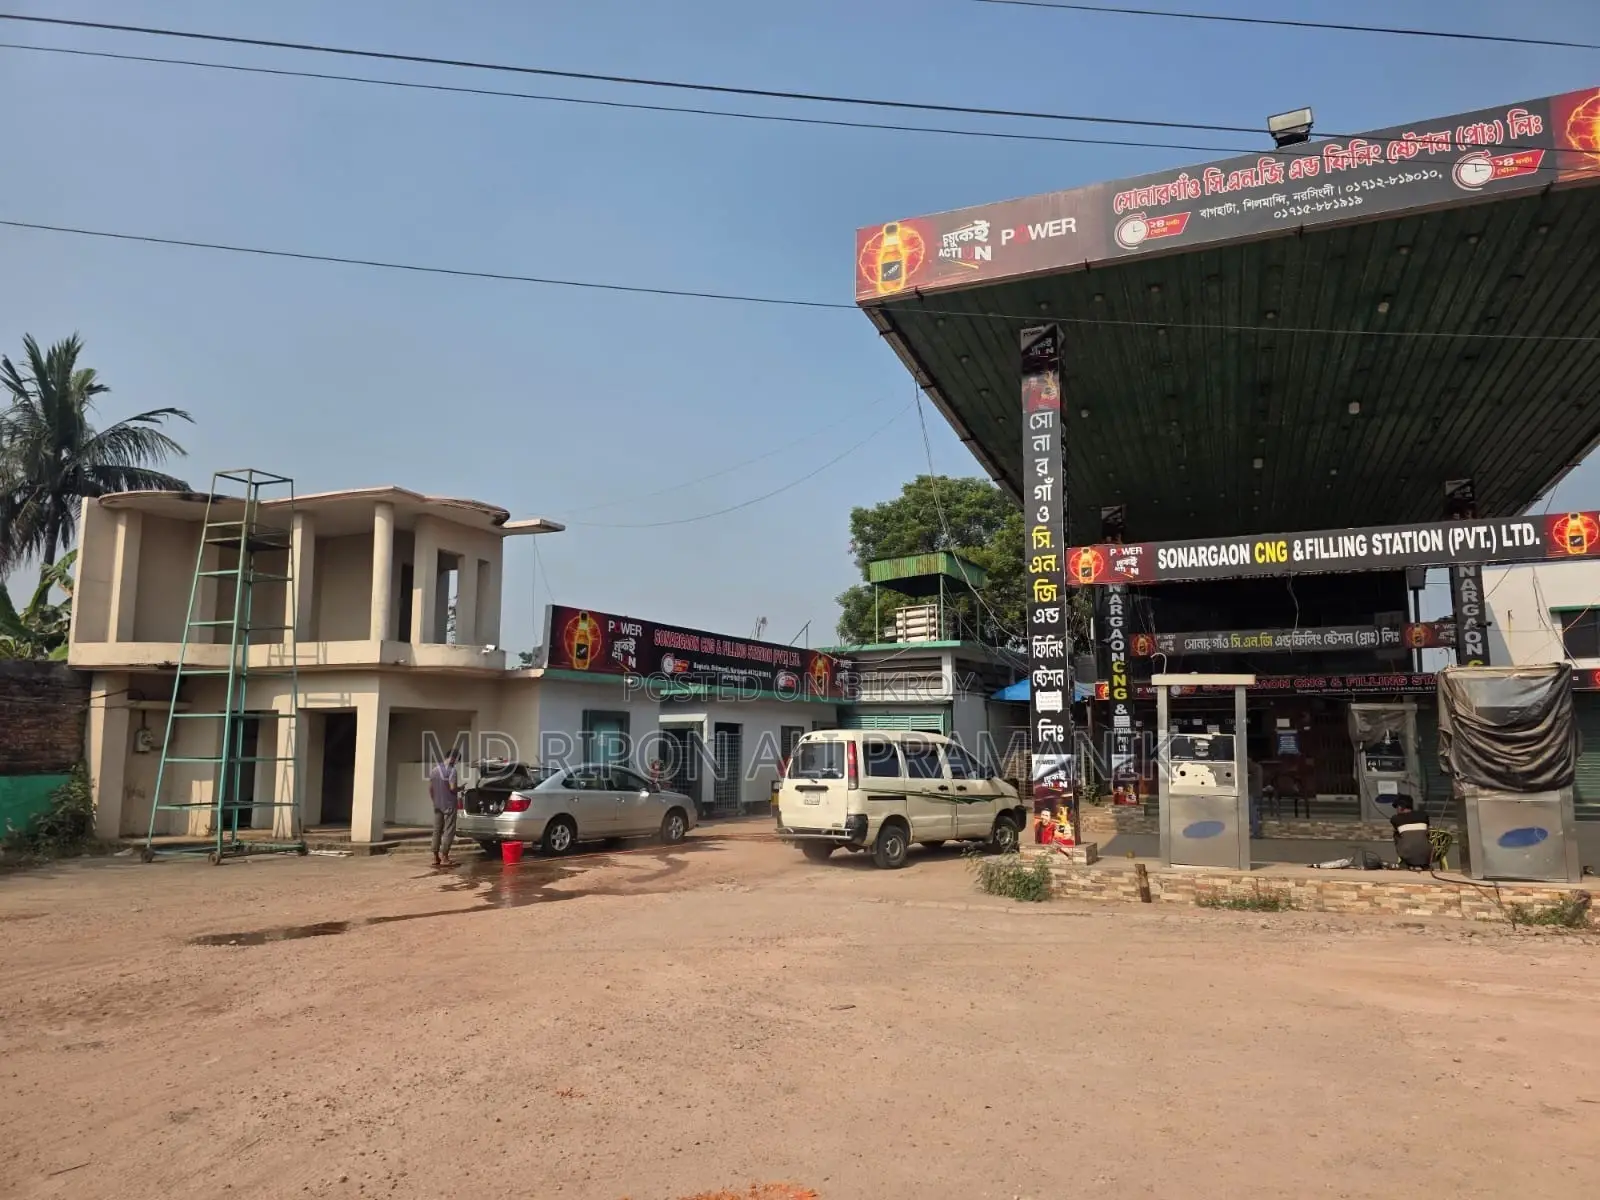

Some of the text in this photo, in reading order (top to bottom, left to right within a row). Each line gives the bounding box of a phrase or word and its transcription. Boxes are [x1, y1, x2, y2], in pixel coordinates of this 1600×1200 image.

[1113, 172, 1201, 214] সোনারগাঁও
[1289, 155, 1320, 179] এন্ড
[1323, 139, 1384, 174] ফিলিং
[1507, 108, 1543, 140] লিঃ
[1158, 542, 1250, 570] SONARGAON
[1254, 540, 1288, 564] CNG
[1372, 529, 1443, 556] STATION
[1449, 526, 1497, 556] (PVT.)
[1501, 522, 1540, 547] LTD.
[1033, 607, 1059, 624] এন্ড
[1032, 635, 1064, 659] ফিলিং
[1115, 704, 1128, 714] &
[1037, 718, 1065, 742] লিঃ
